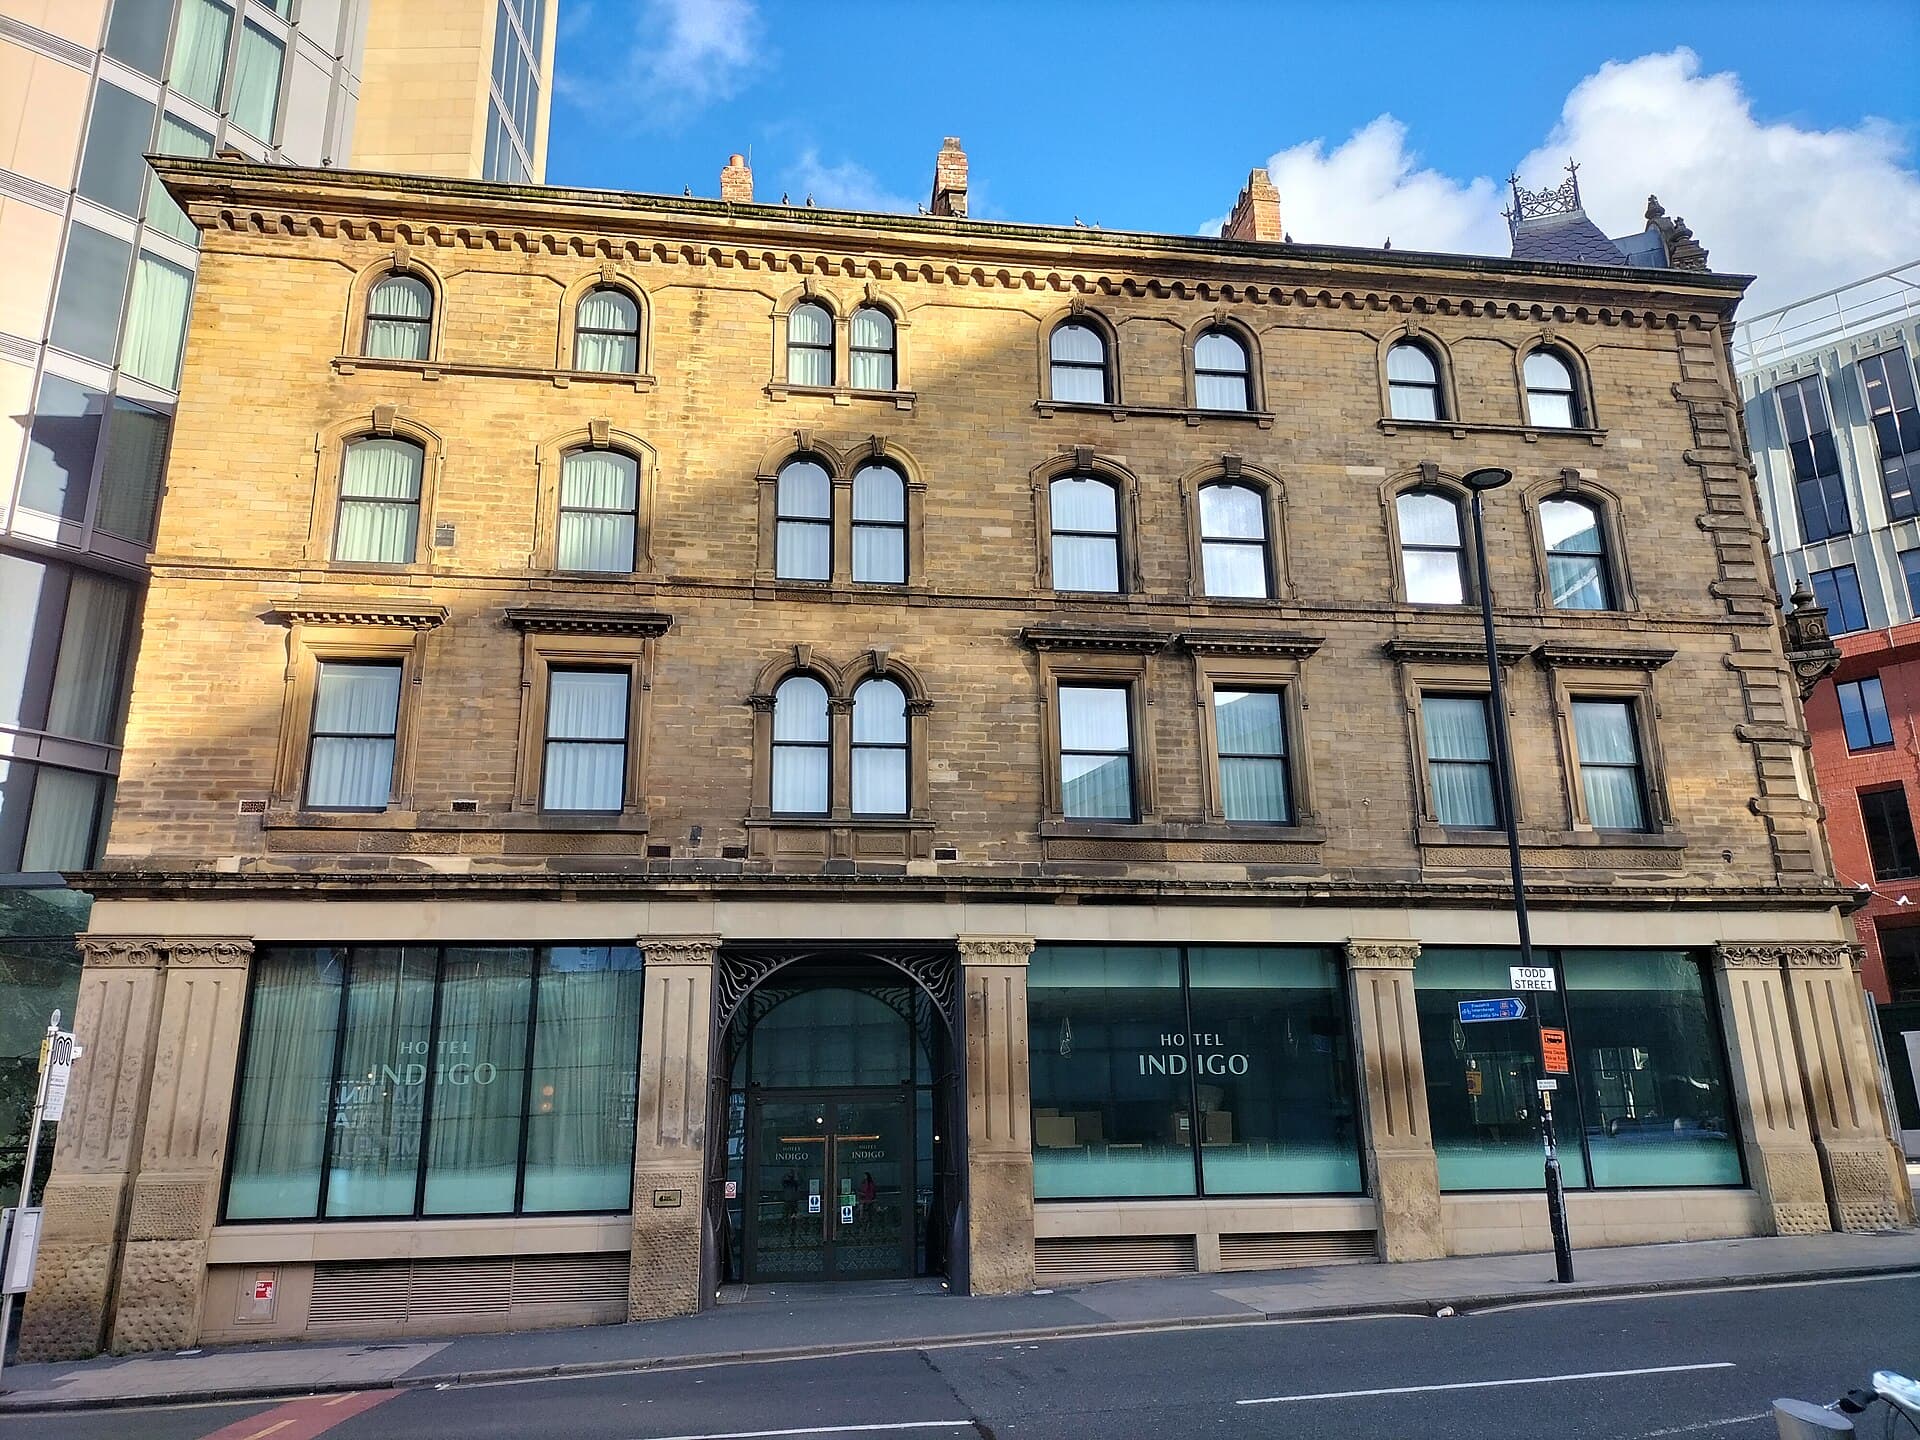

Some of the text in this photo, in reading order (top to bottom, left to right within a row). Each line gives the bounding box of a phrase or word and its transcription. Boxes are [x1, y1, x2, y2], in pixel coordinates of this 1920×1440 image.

[1518, 968, 1546, 978] TODD
[1514, 979, 1552, 989] STREET
[1160, 1033, 1224, 1046] HOTEL
[400, 1041, 471, 1054] HOTEL
[1139, 1054, 1248, 1075] INDIGO
[369, 1062, 497, 1086] INDIGO
[775, 1152, 808, 1160] INDIGO
[852, 1151, 885, 1159] INDIGO
